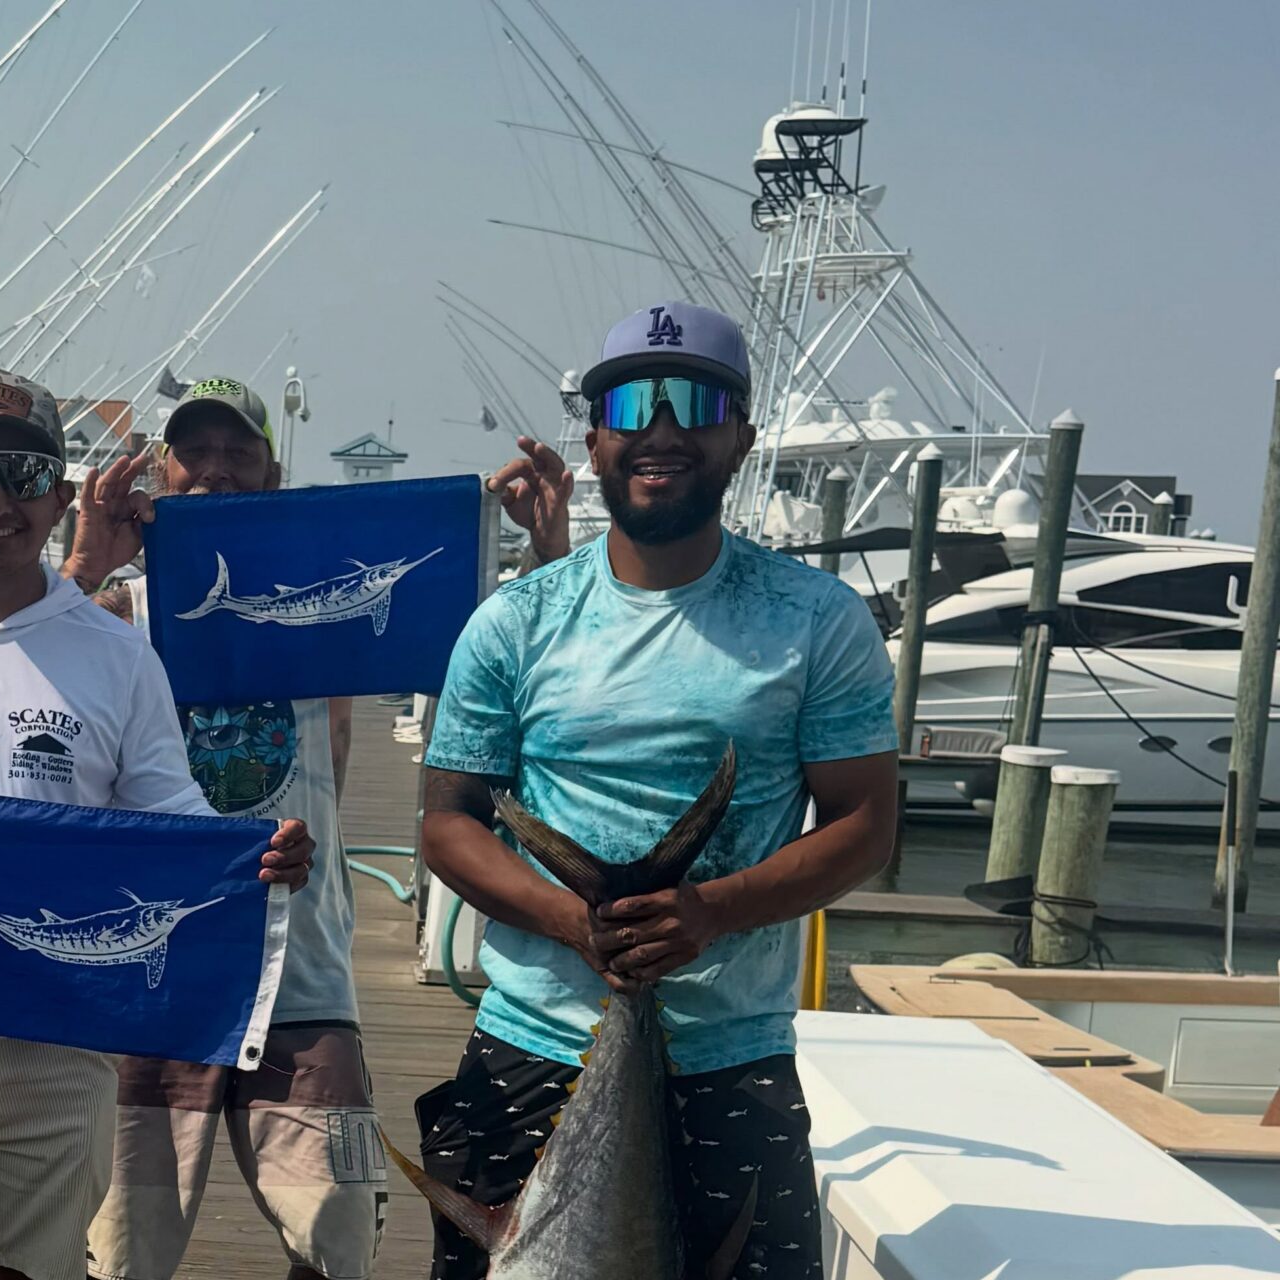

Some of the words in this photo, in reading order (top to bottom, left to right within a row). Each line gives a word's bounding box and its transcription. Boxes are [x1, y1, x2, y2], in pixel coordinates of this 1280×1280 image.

[647, 306, 683, 346] LA
[8, 708, 83, 735] SCATES
[15, 724, 74, 742] CORPORATION
[11, 760, 34, 770] Siding
